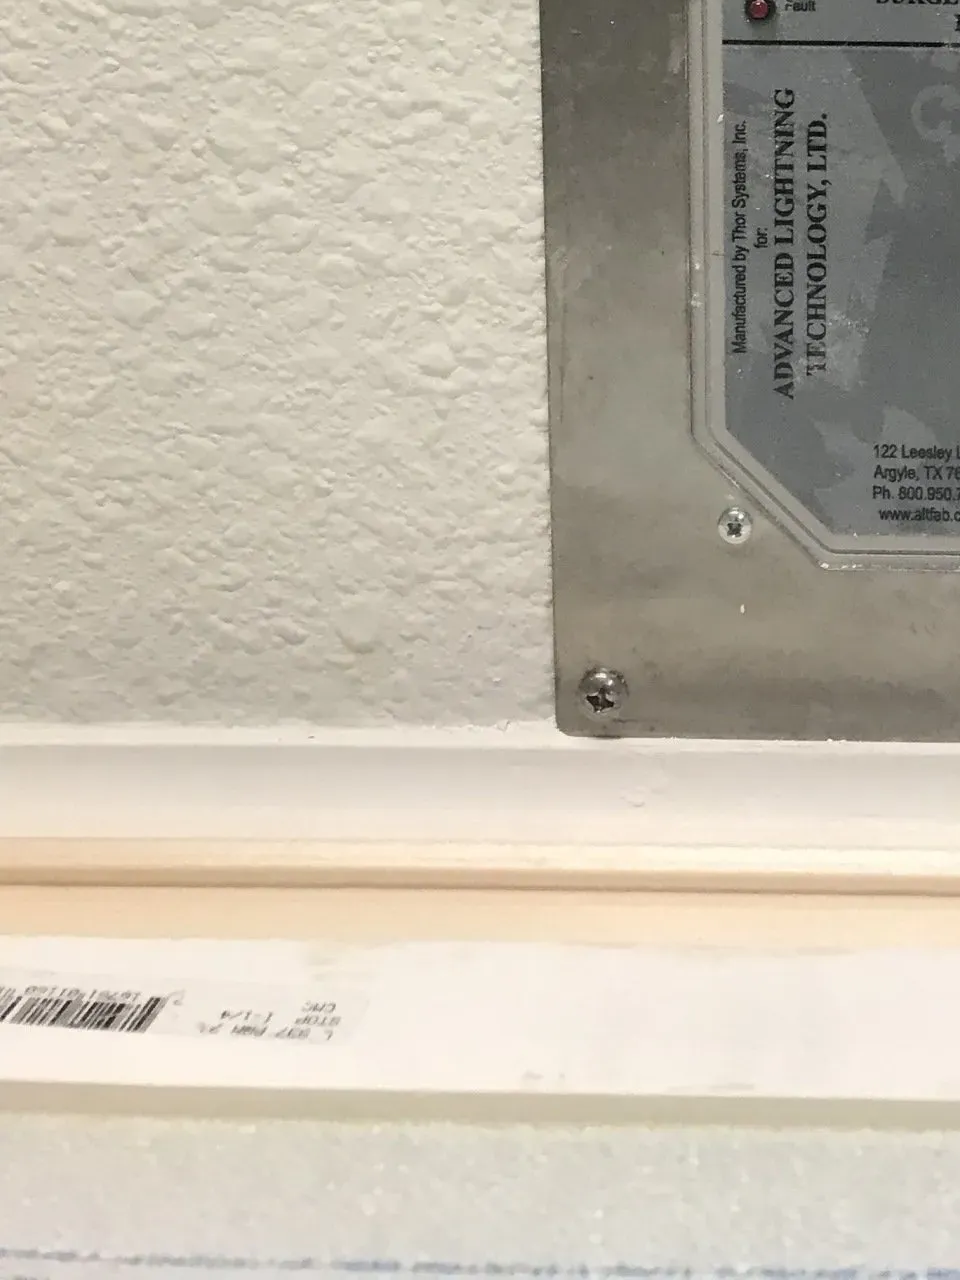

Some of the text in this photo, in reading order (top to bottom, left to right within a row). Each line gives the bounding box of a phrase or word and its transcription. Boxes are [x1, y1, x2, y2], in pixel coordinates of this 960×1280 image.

[784, 0, 817, 13] Fault
[731, 120, 750, 354] Manufactured by Thor Systems, Inc.
[753, 227, 769, 249] for:
[773, 88, 795, 400] ADVANCED LIGHTNING
[806, 113, 832, 376] TECHNOLOGY, LTD.
[873, 444, 898, 459] 122
[901, 445, 953, 463] Leesley
[873, 464, 920, 483] Argyle,
[924, 465, 944, 480] TX
[872, 485, 895, 500] Ph.
